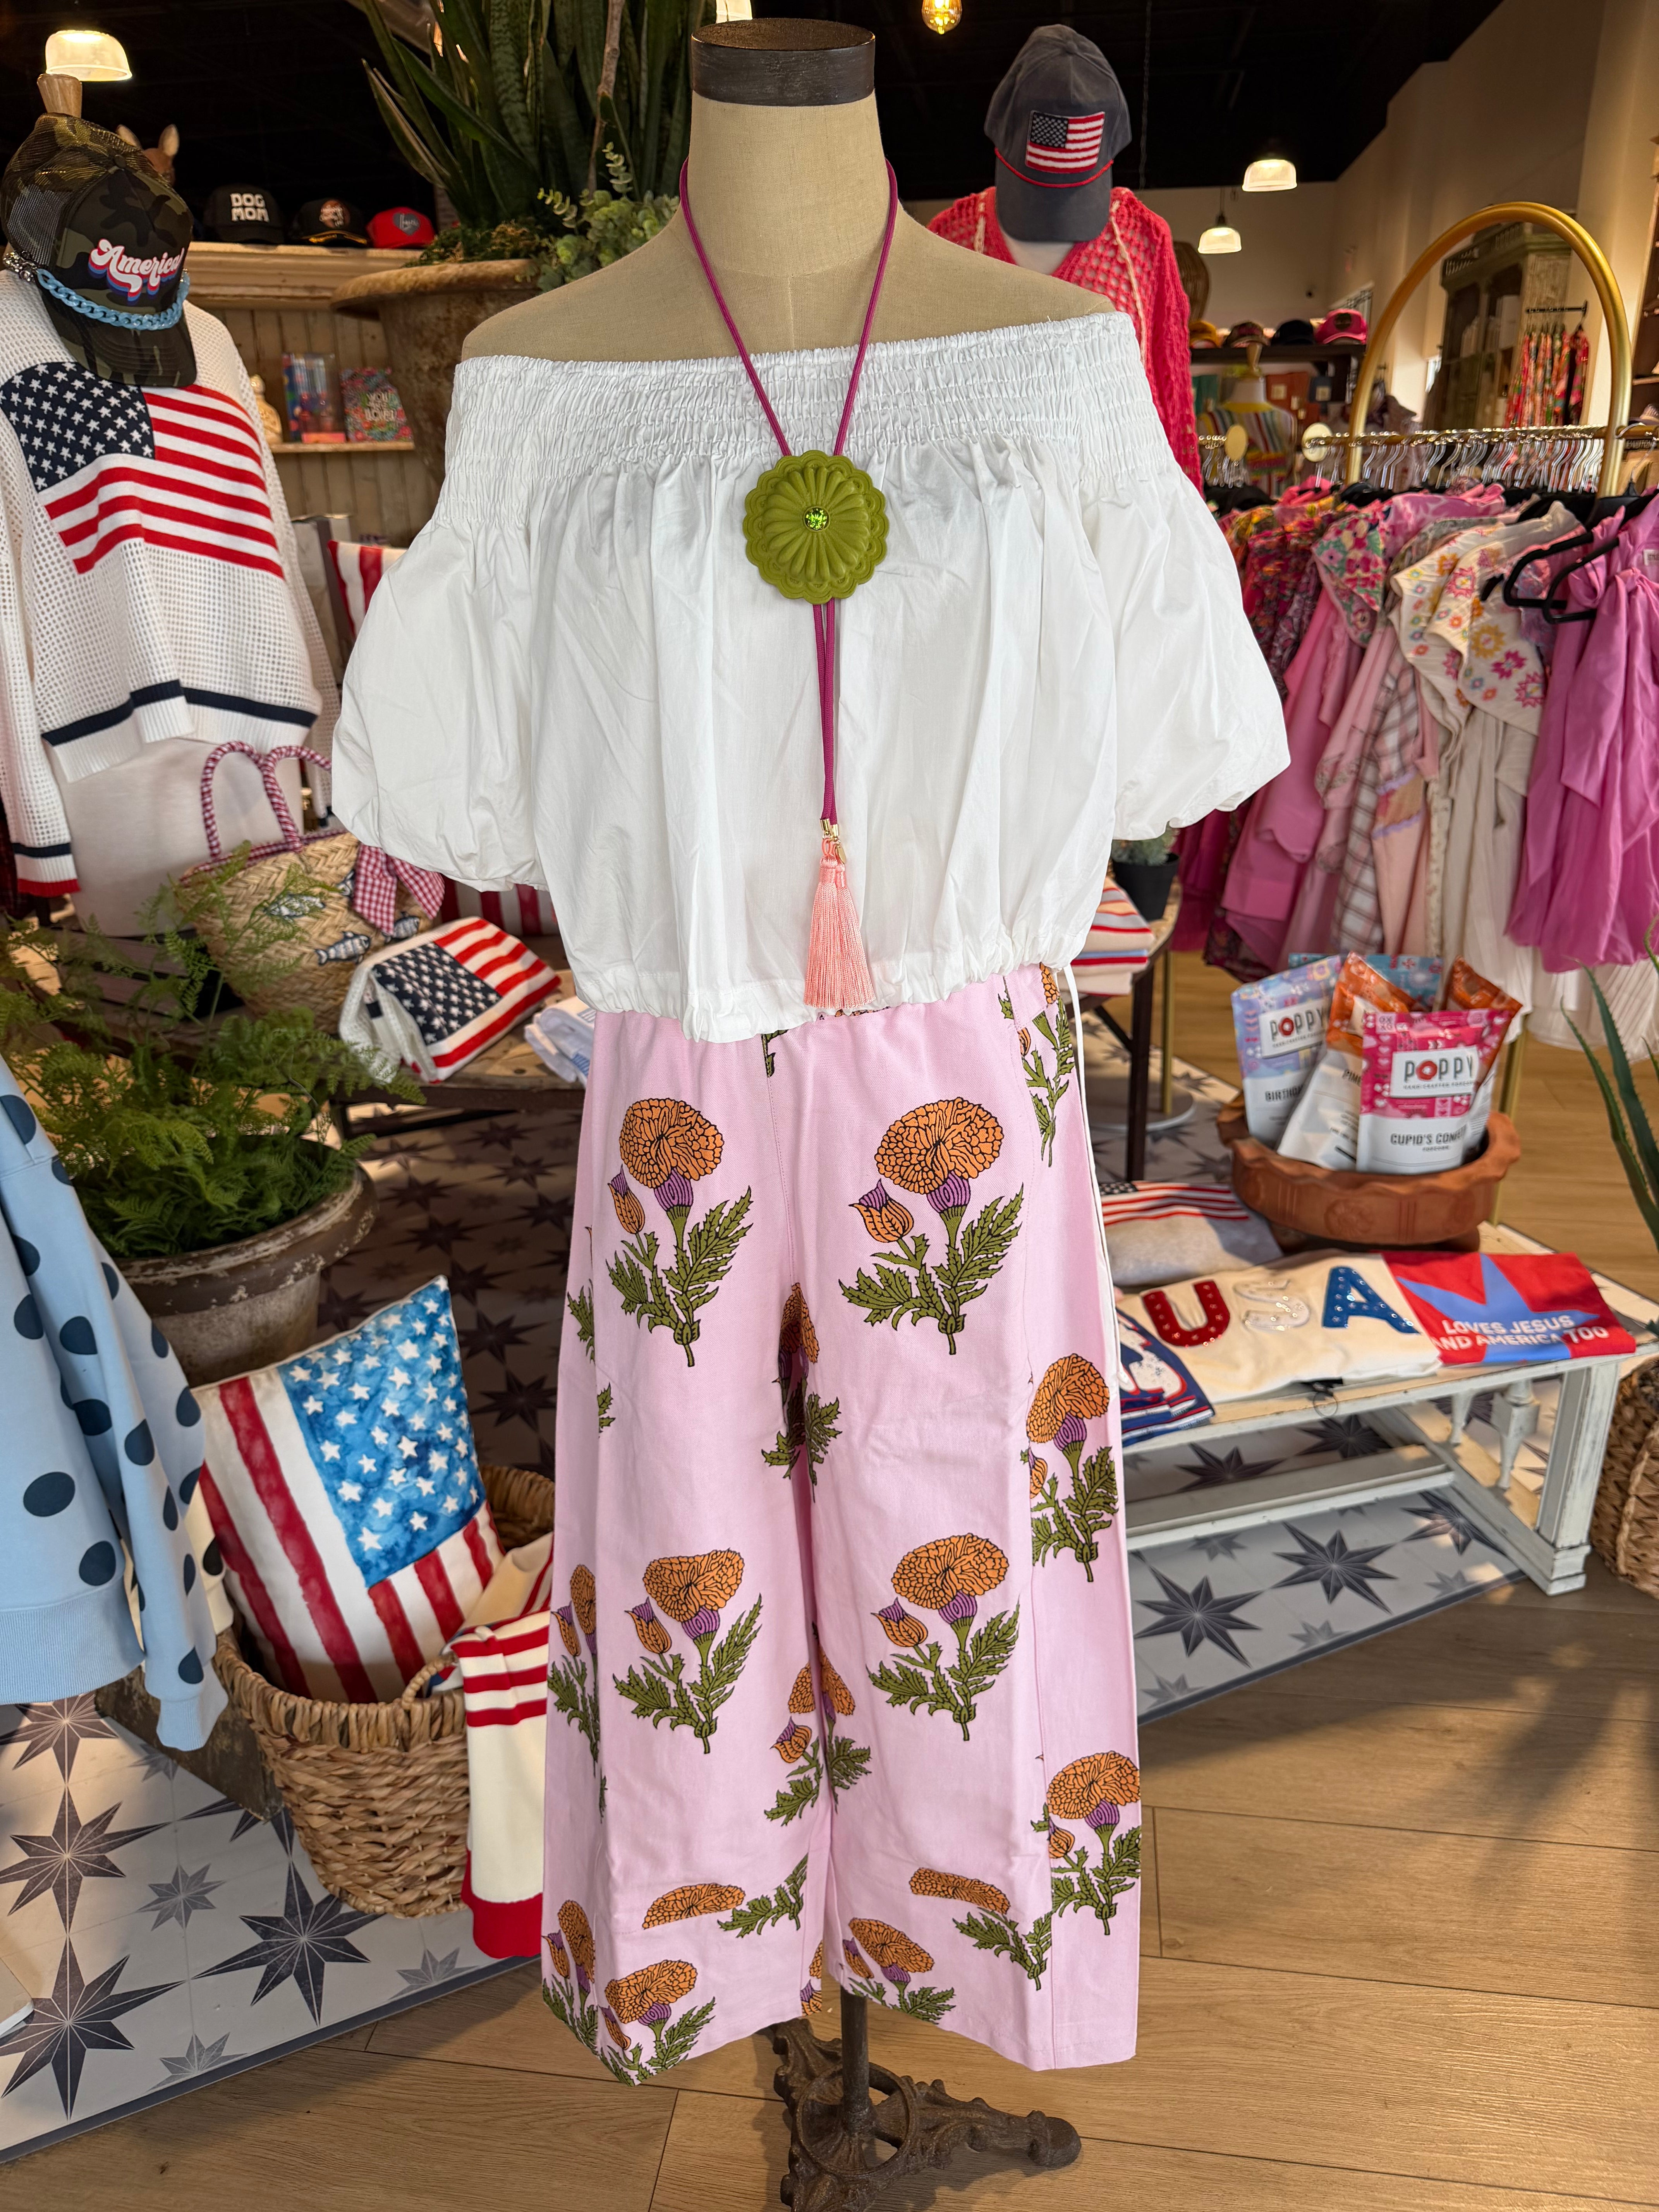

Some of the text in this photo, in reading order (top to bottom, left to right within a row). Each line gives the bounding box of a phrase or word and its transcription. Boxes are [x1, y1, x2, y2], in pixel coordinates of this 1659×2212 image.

[230, 193, 266, 208] DOG
[231, 207, 270, 223] MOM
[1404, 1056, 1473, 1083] POPPY
[1391, 1133, 1433, 1146] CUPID'S
[1442, 1315, 1575, 1335] LOVES JESUS
[1476, 1333, 1565, 1346] AMERICA
[1564, 1326, 1609, 1344] TOO
